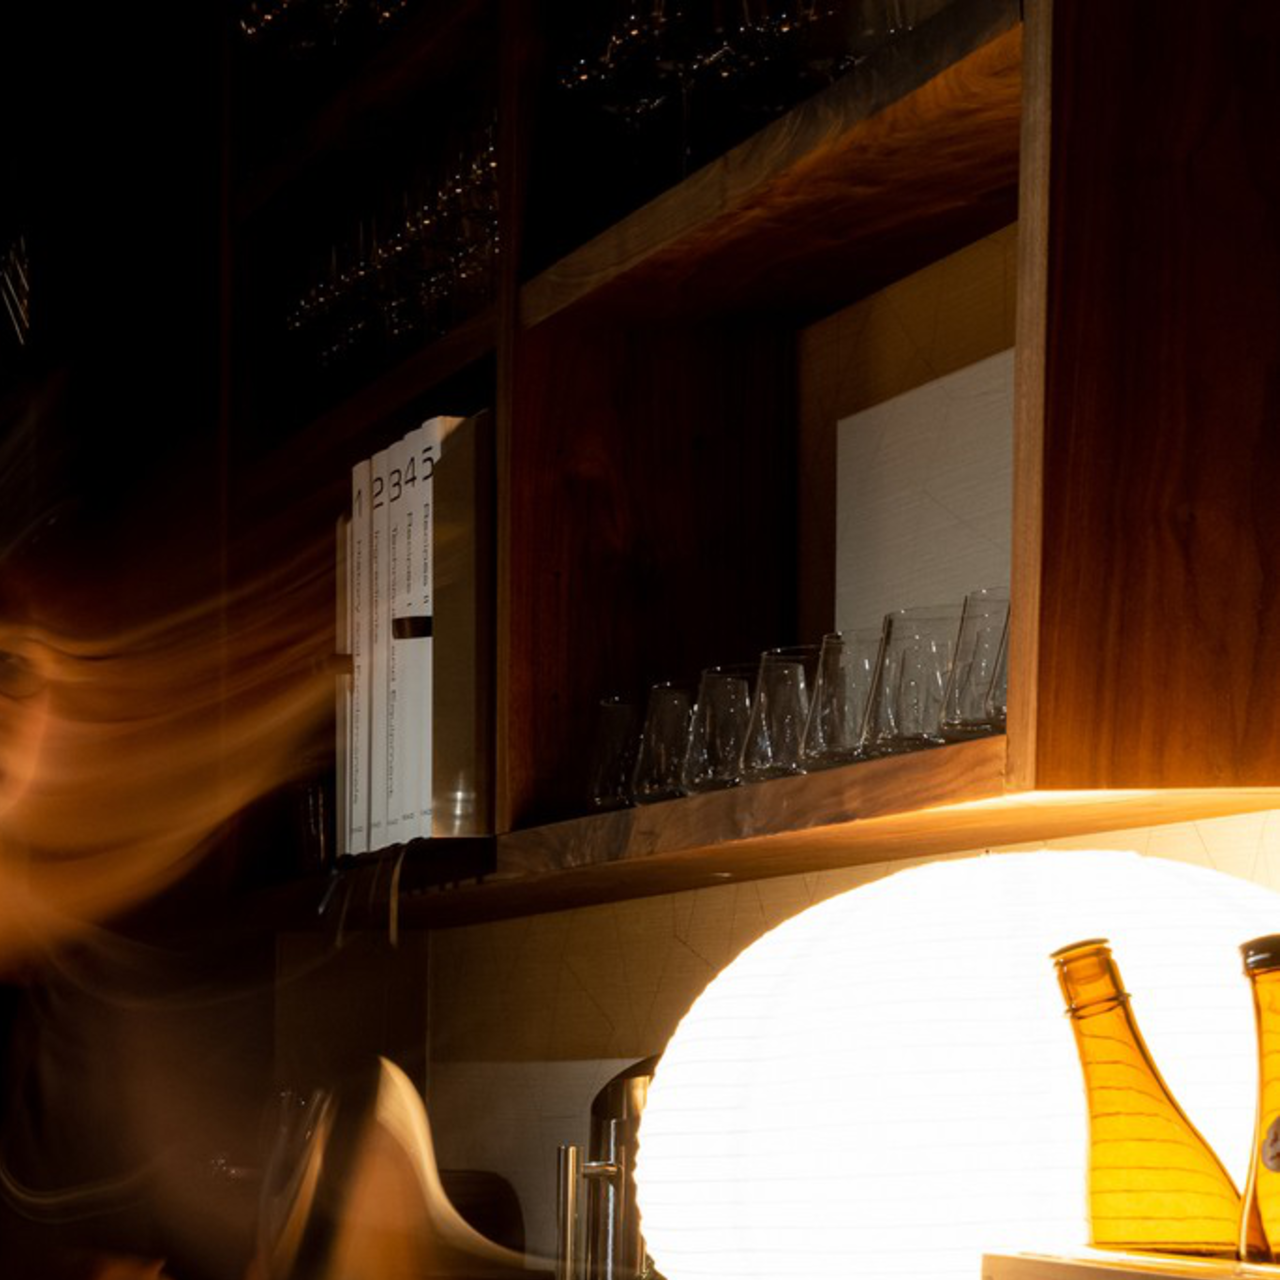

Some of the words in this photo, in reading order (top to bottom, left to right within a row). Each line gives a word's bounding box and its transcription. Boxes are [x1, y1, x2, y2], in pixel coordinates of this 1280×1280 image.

[404, 456, 417, 488] 4
[421, 446, 434, 482] 5
[372, 476, 384, 510] 2
[389, 468, 402, 503] 3
[355, 489, 362, 518] 1
